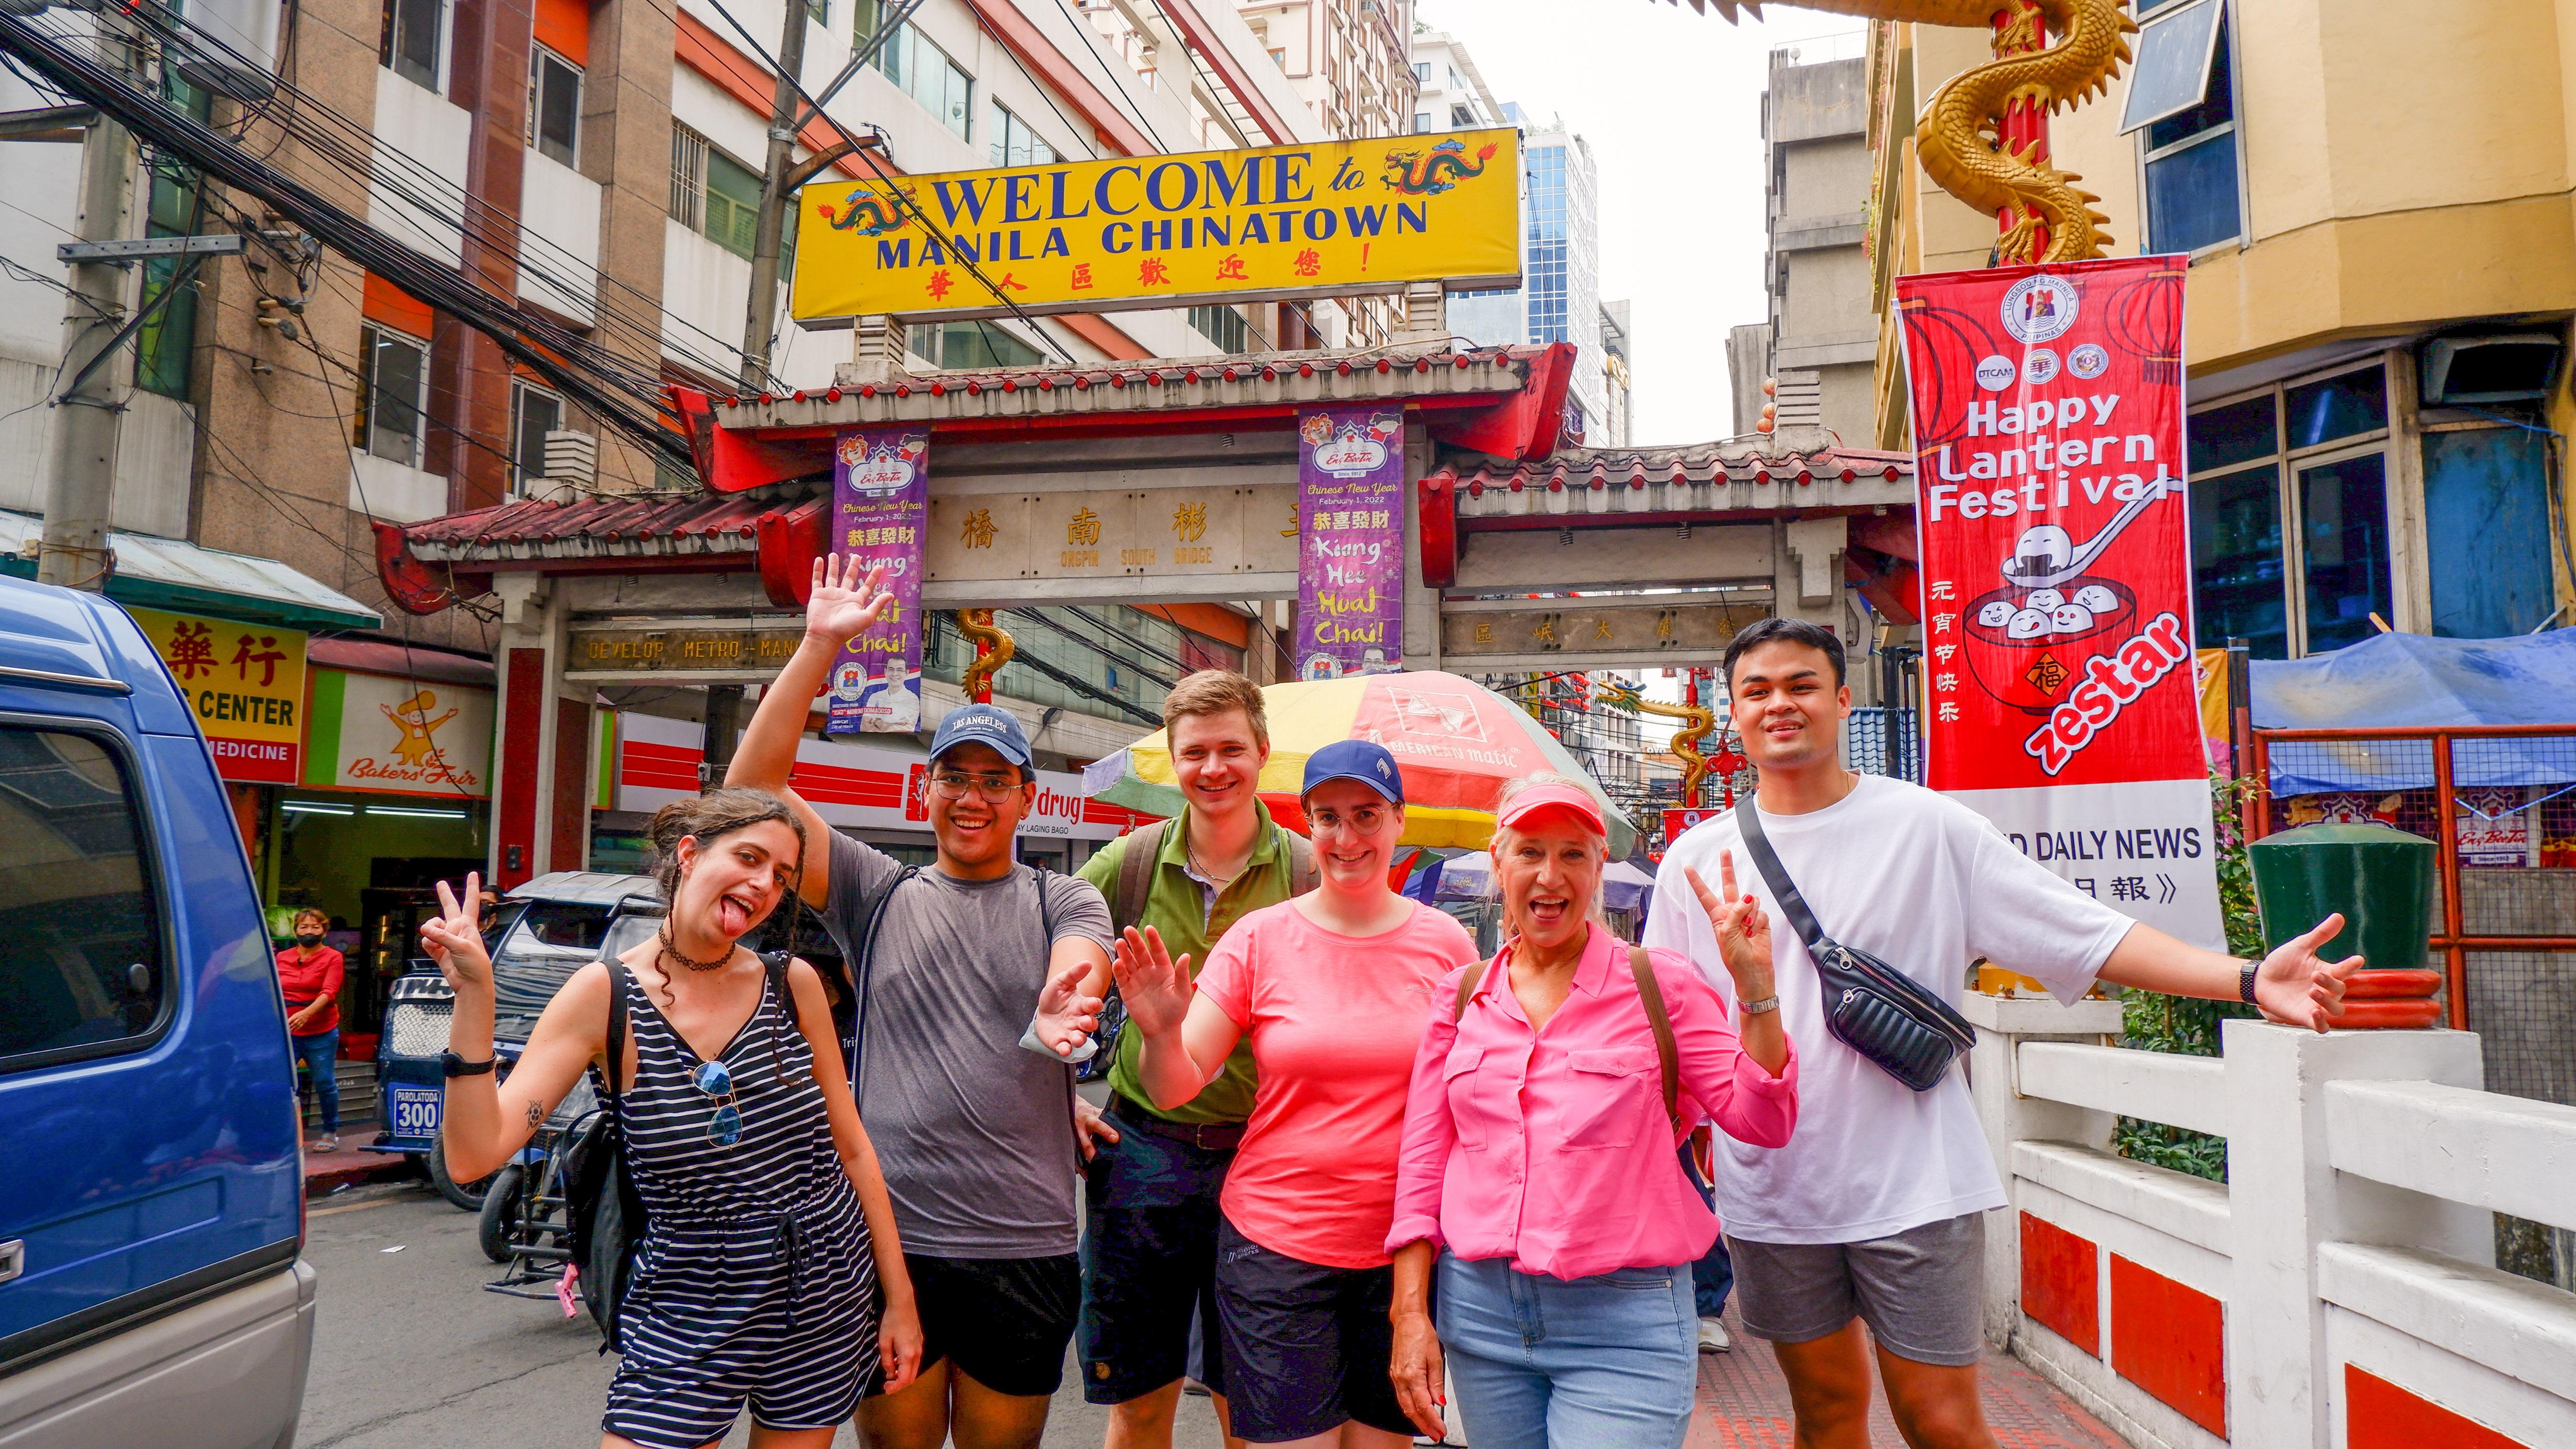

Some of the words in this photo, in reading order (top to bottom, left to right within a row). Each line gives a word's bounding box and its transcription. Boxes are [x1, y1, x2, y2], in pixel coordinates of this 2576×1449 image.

[931, 152, 1313, 228] WELCOME
[1328, 157, 1365, 191] to
[877, 227, 1070, 269] MANILA
[1101, 201, 1427, 253] CHINATOWN
[2005, 281, 2031, 311] LUNGSOD
[2047, 279, 2074, 302] MAYNILA
[2021, 327, 2061, 340] PILIPINAS
[1978, 368, 2013, 378] DTCAM
[1968, 394, 2120, 437] Happy
[1939, 434, 2155, 482] Lantern
[1308, 485, 1343, 495] Chinese
[1346, 483, 1370, 494] New
[1371, 483, 1398, 496] Year
[1930, 464, 2167, 522] Festival
[843, 503, 876, 513] Chinese
[899, 500, 923, 512] Year
[1313, 510, 1389, 531] 恭喜發財
[848, 526, 916, 547] 恭喜發財
[1060, 550, 1099, 567] ONGPIN
[1121, 548, 1156, 566] SOUTH
[1175, 546, 1213, 564] BRIDGE
[1326, 563, 1367, 587] Hee
[1316, 586, 1383, 617] Huat
[845, 633, 906, 654] Chai!
[1315, 620, 1384, 644] Chai!
[166, 621, 287, 687] 藥行
[589, 641, 664, 659] DEVELOP
[1932, 580, 1960, 723] 元宵节快乐
[2035, 661, 2062, 687] 福
[2025, 613, 2187, 774] zestar
[199, 690, 294, 726] CENTER
[952, 718, 965, 731] LOS
[965, 715, 1007, 733] ANGELESS
[425, 764, 479, 785] Fair
[1037, 787, 1080, 825] drug
[2037, 830, 2108, 861] DAILY
[2116, 827, 2201, 859] NEWS
[398, 1092, 438, 1102] PAROLATODA
[399, 1103, 436, 1128] 300
